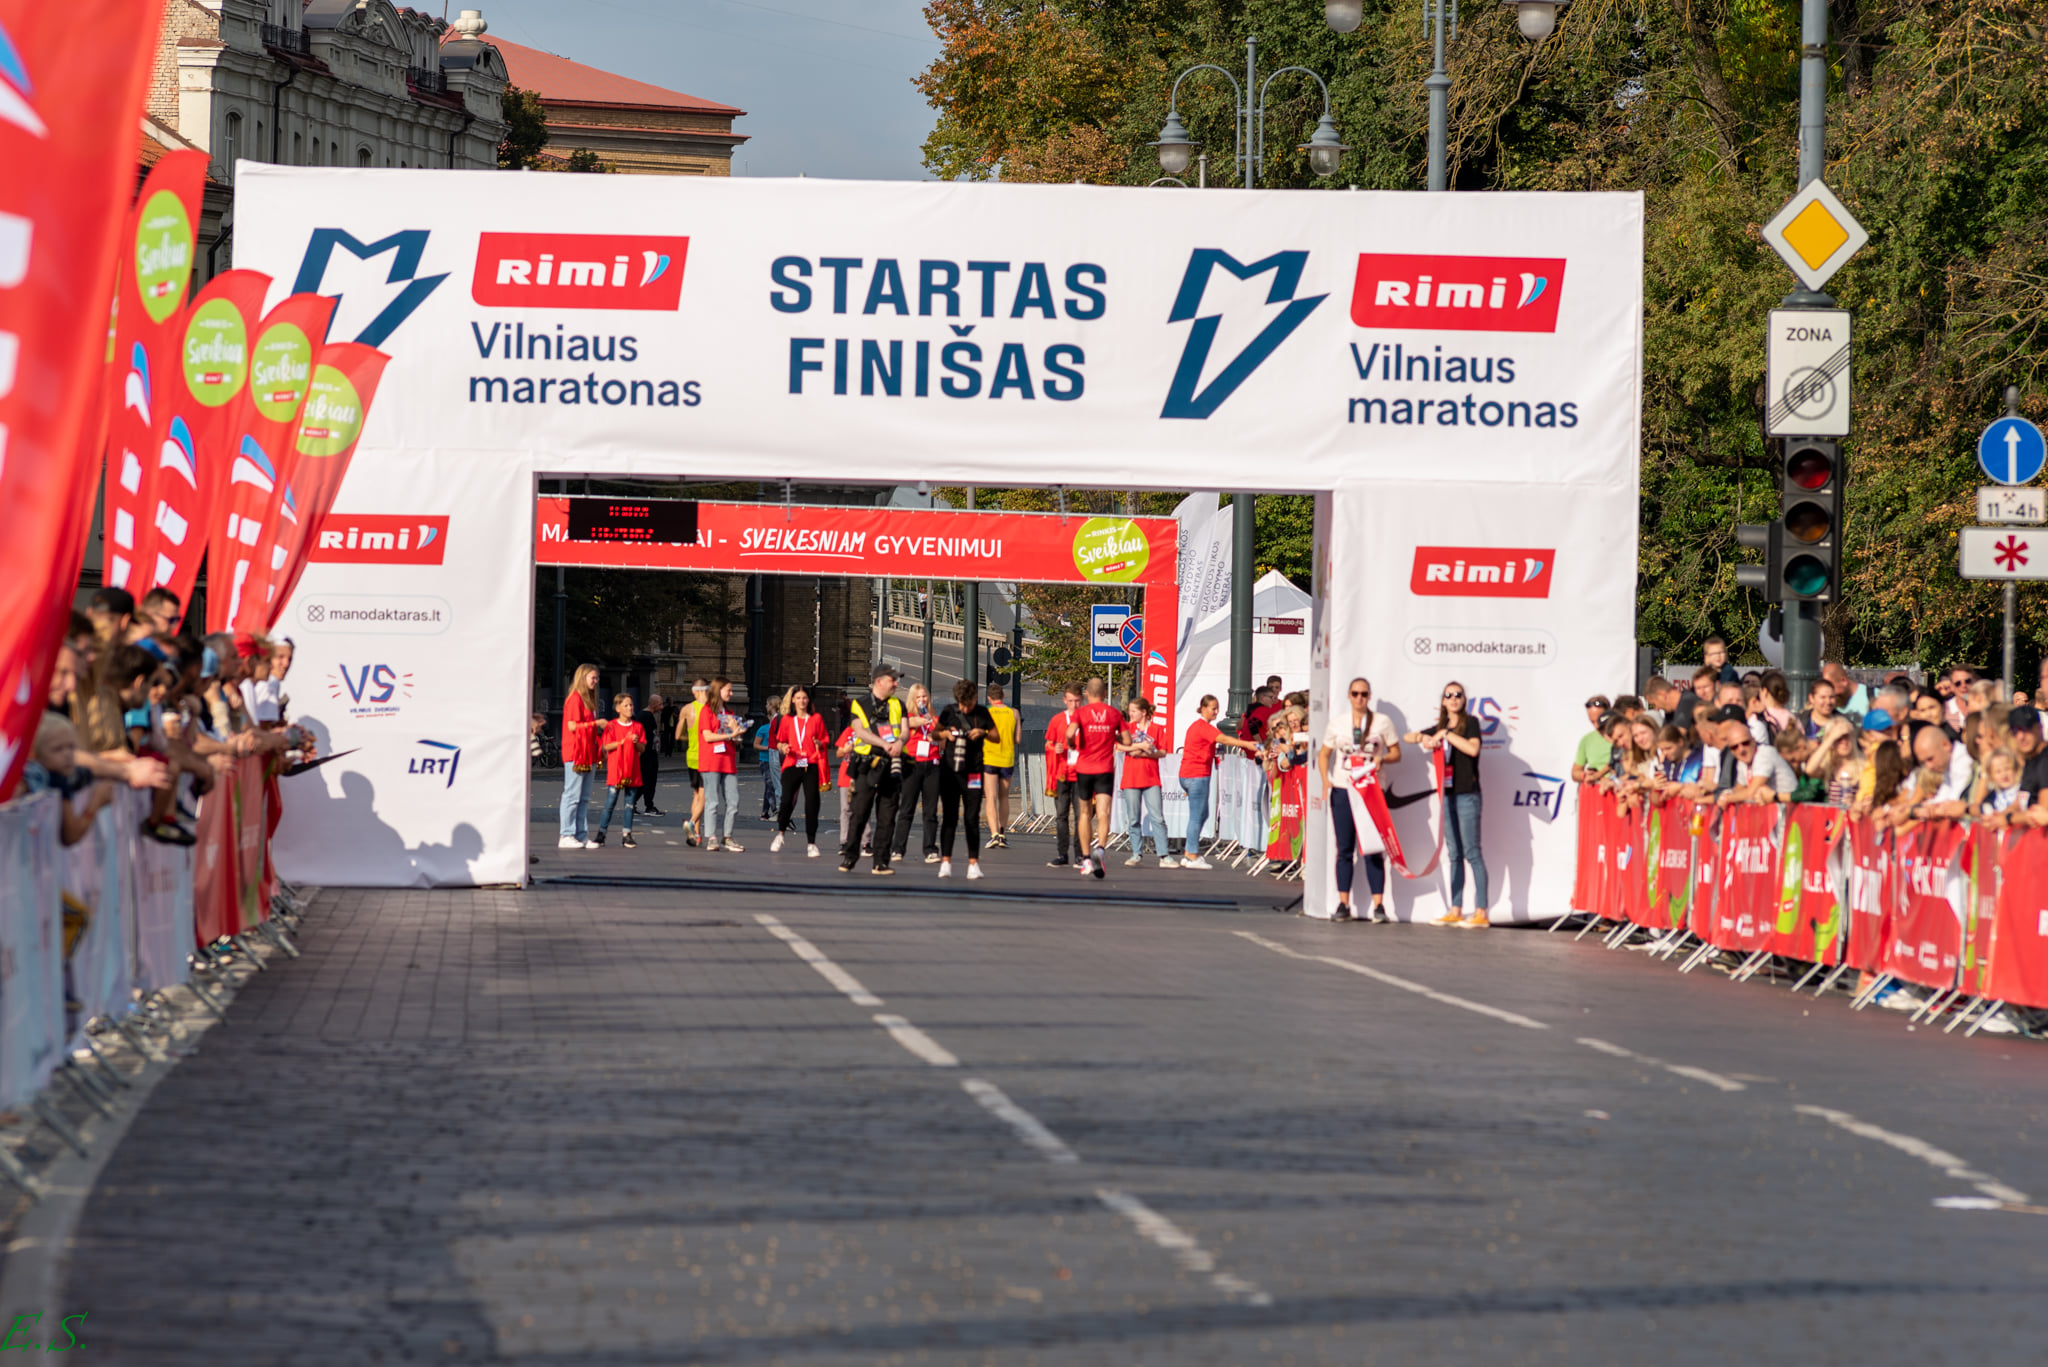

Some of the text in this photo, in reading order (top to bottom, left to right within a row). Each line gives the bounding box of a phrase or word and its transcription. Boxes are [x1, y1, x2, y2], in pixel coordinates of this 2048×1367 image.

[496, 253, 629, 287] Rimi
[770, 255, 1107, 320] STARTAS
[1374, 275, 1507, 309] Rimi
[470, 321, 638, 362] Vilniaus
[1786, 328, 1833, 341] ZONA
[789, 324, 1086, 401] FINIŠAS
[1349, 343, 1515, 384] Vilniaus
[469, 371, 702, 407] maratonas
[1347, 393, 1579, 428] maratonas
[318, 527, 411, 551] Rimi
[739, 527, 867, 553] SVEIKESNIAM
[874, 535, 1002, 558] GYVENIMUI
[1078, 535, 1144, 565] Sveikiau
[1181, 549, 1197, 604] IR GYDYMO
[1200, 540, 1220, 613] DIAGNOSTIKOS
[1210, 560, 1225, 613] IR GYDYMO
[1425, 559, 1517, 584] Rimi
[1219, 571, 1232, 608] ENTRAS
[330, 607, 441, 623] manodaktaras.lt
[1436, 640, 1547, 656] manodaktaras.lt
[339, 663, 397, 705] VS
[408, 758, 451, 775] LRT
[1512, 789, 1556, 807] LRT
